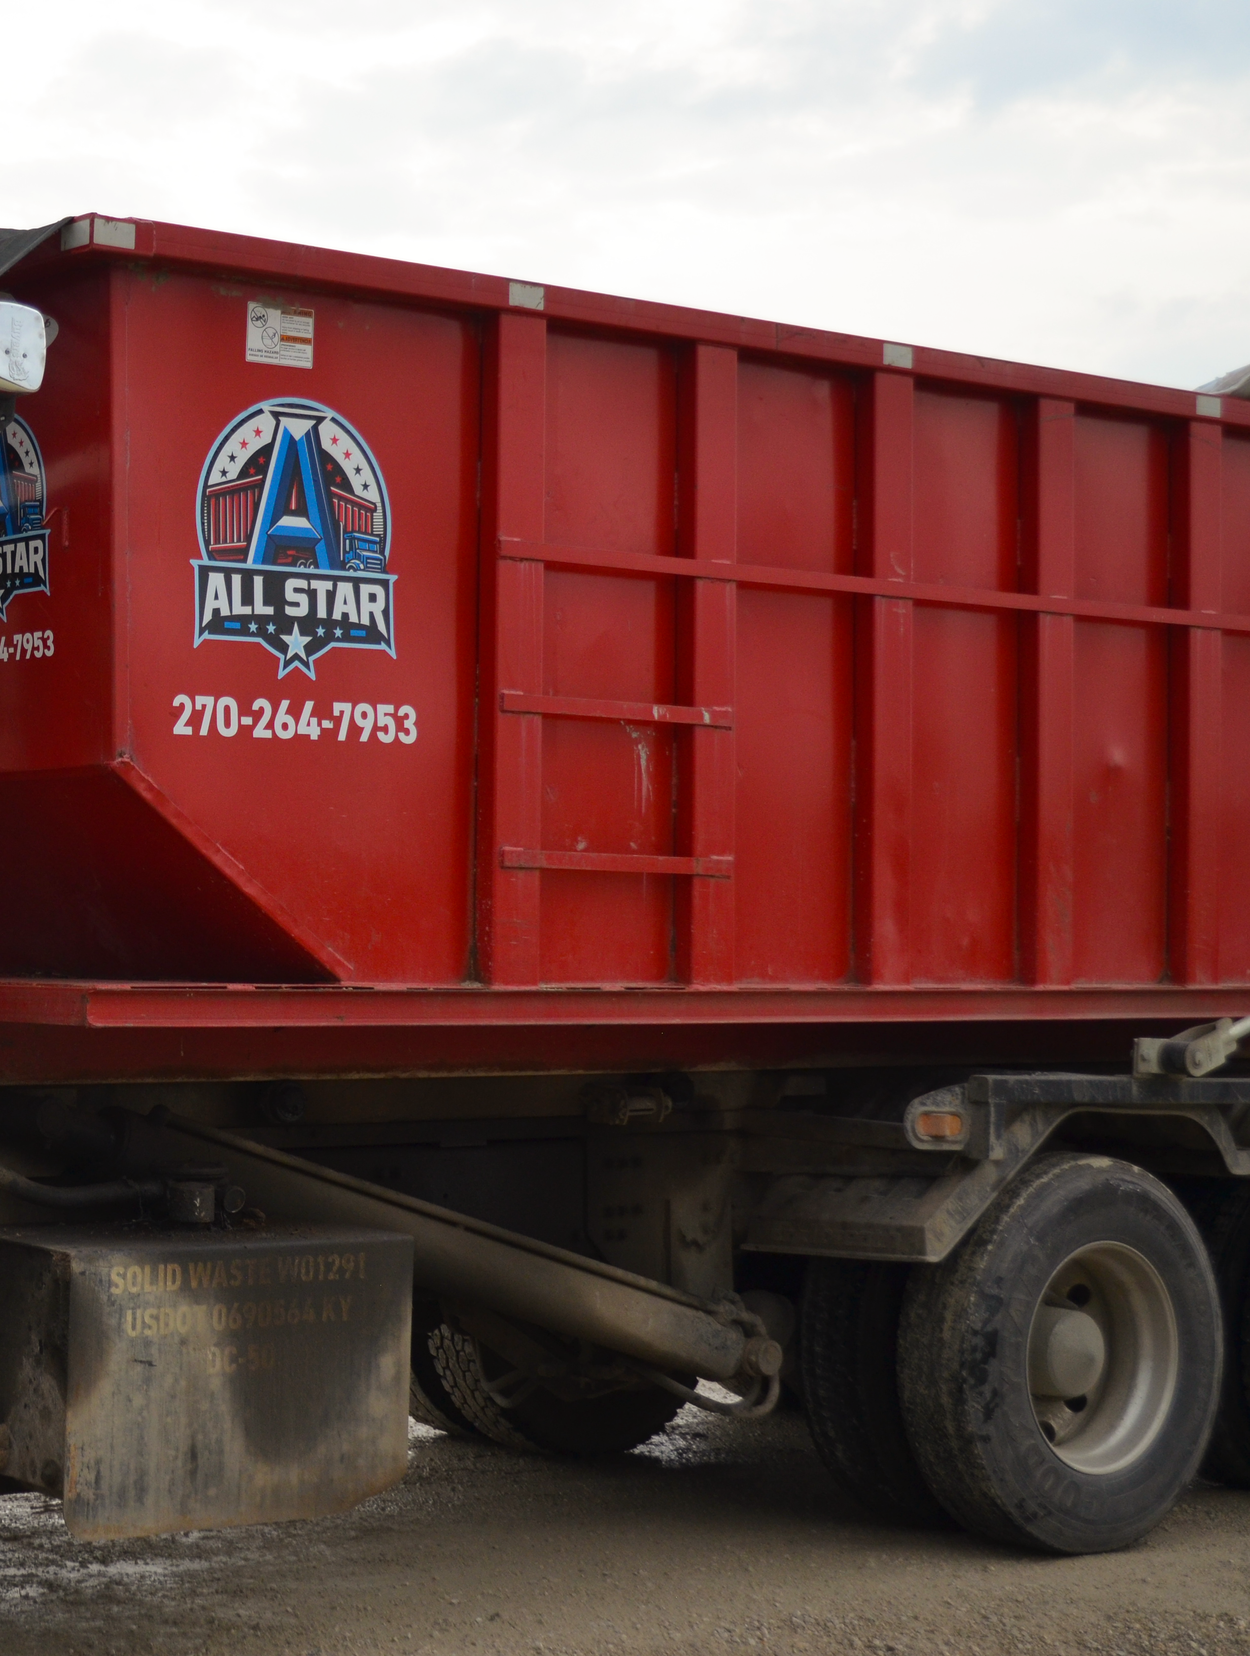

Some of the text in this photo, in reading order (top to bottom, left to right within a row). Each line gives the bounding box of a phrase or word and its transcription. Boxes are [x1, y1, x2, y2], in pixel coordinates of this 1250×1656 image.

[202, 572, 388, 640] ALL STAR
[172, 694, 417, 744] 270-264-7953
[110, 1263, 182, 1294] SOLID
[188, 1257, 272, 1290] WASTE
[125, 1304, 207, 1338] USDOT
[321, 1295, 353, 1323] KY
